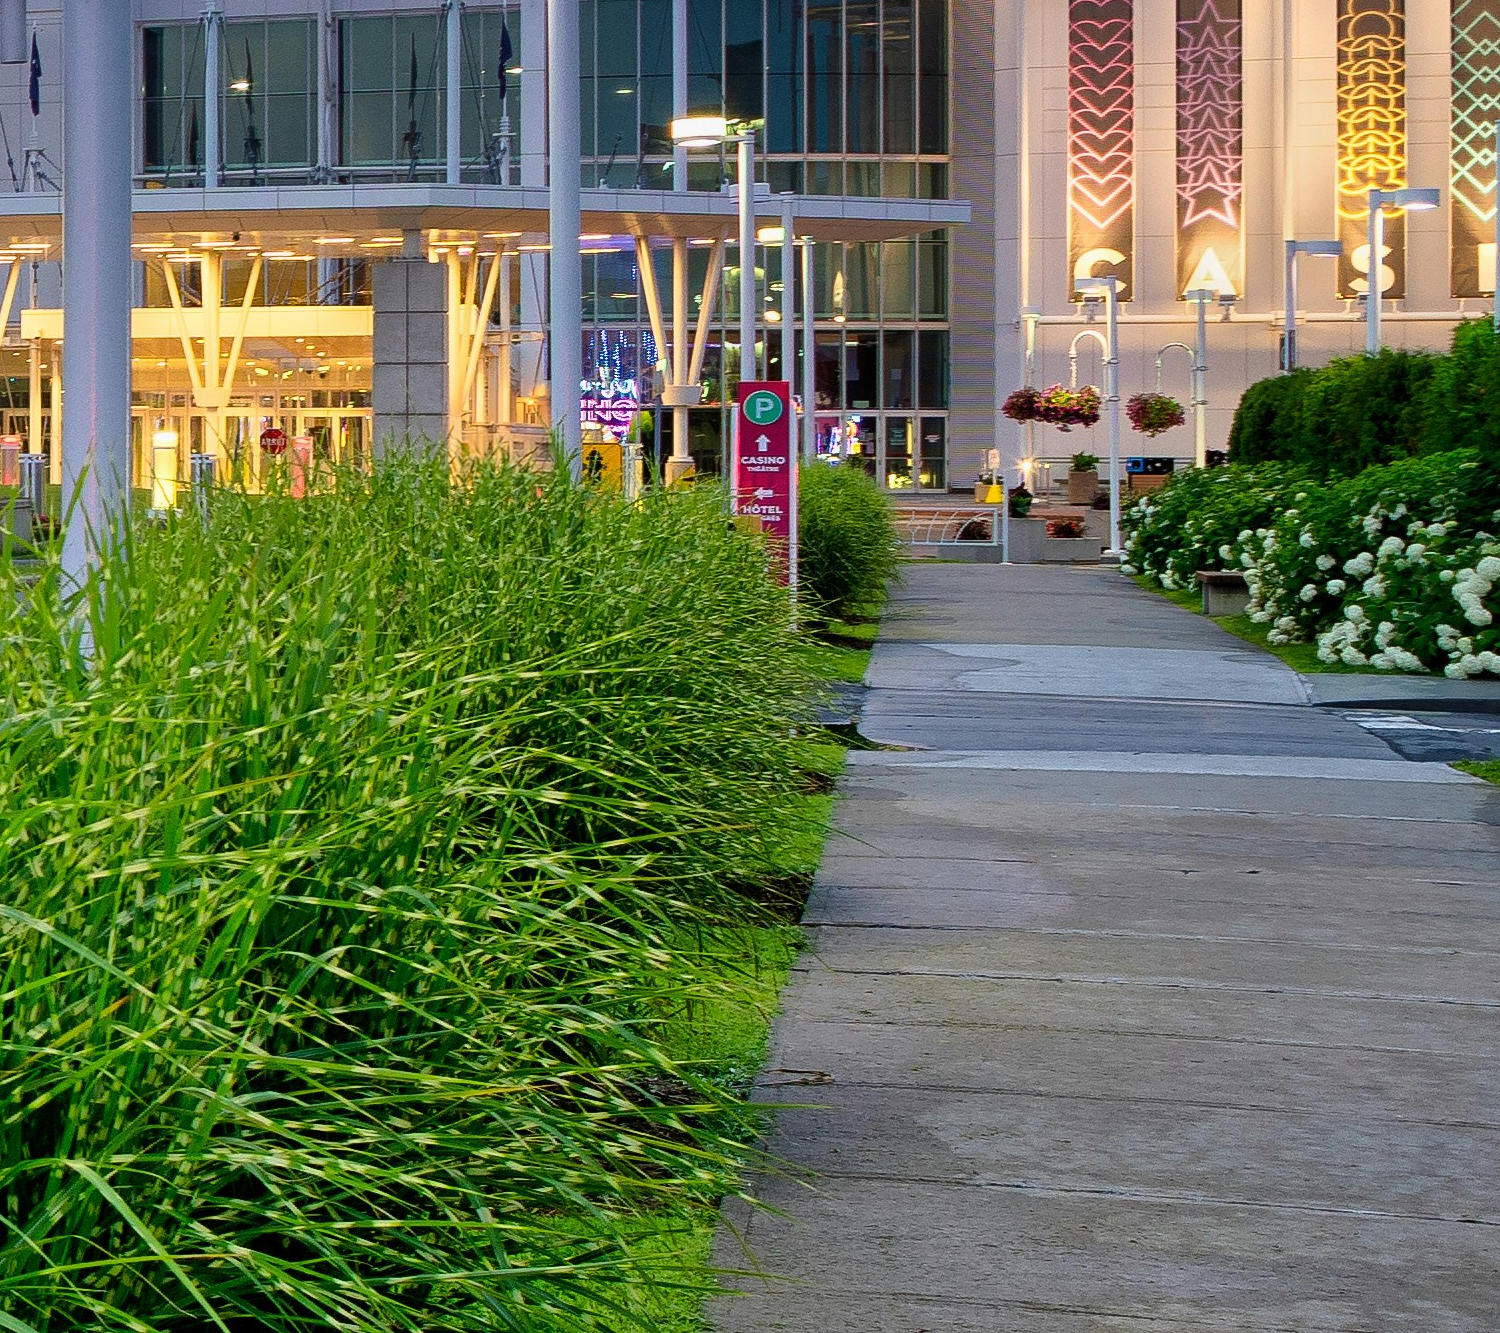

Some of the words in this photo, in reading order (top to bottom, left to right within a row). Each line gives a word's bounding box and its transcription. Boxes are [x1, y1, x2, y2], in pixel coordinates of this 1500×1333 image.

[755, 397, 774, 419] P
[741, 456, 786, 465] CASINO
[742, 503, 784, 514] HÔTEL
